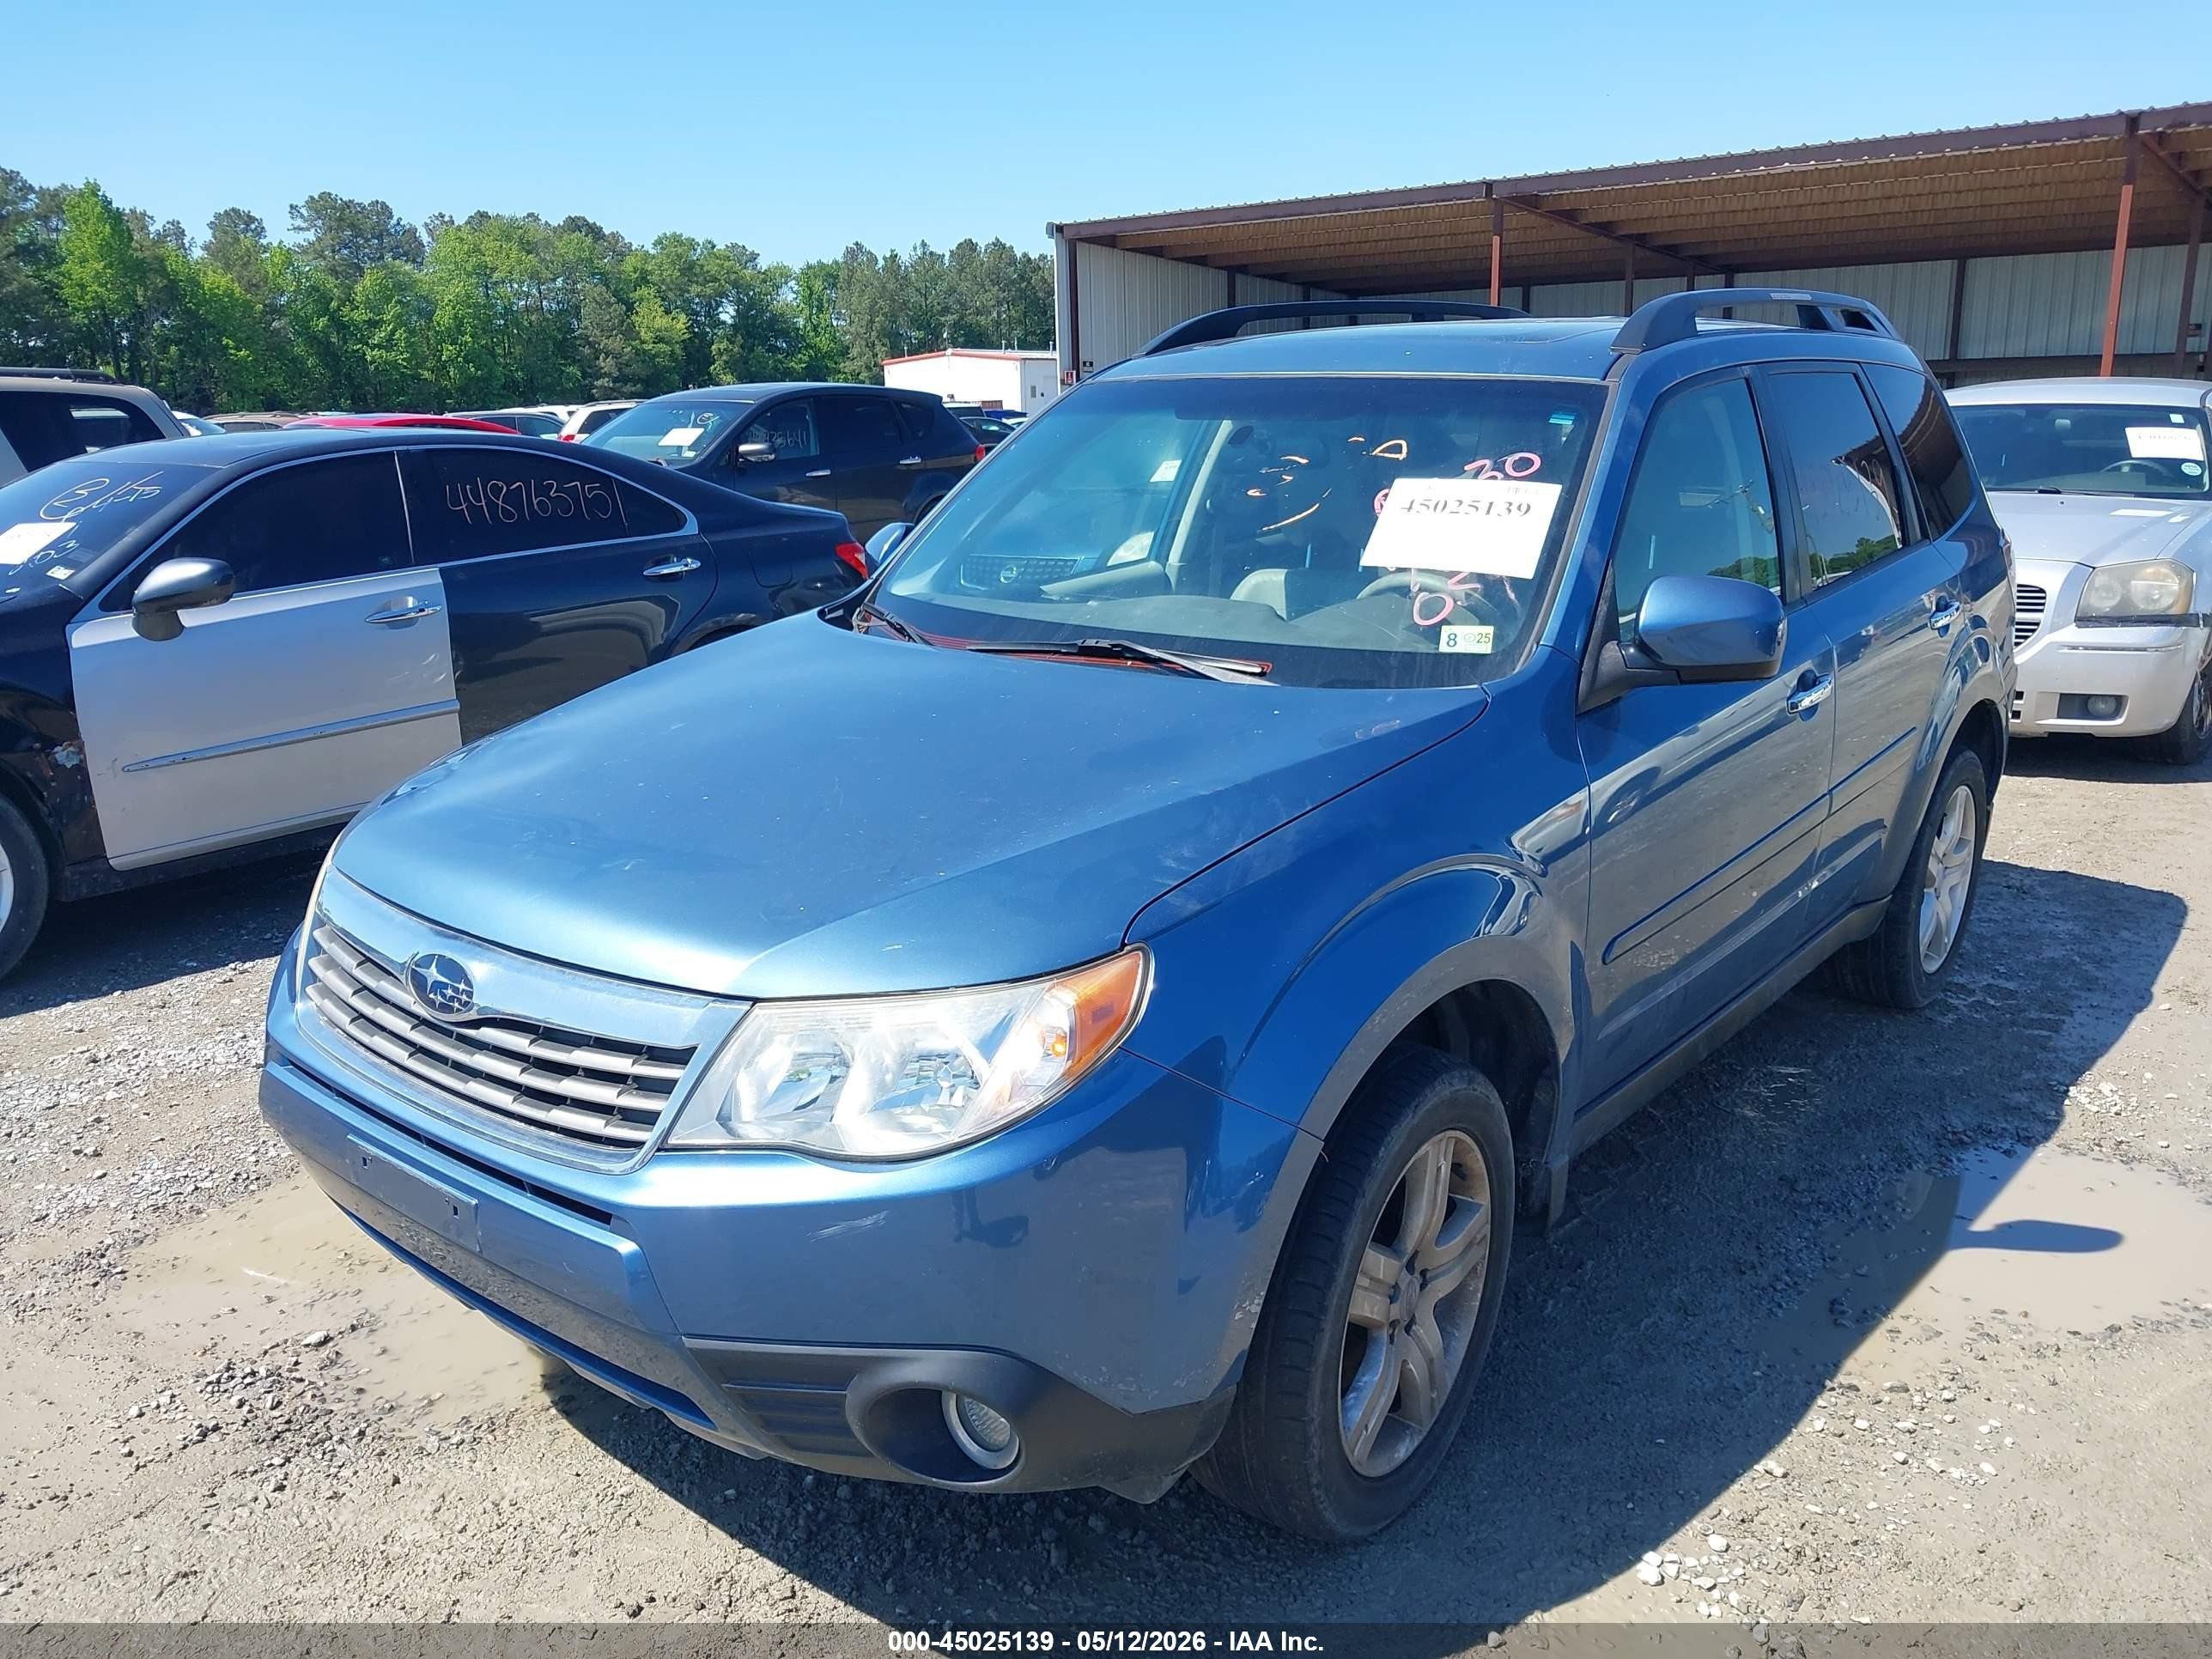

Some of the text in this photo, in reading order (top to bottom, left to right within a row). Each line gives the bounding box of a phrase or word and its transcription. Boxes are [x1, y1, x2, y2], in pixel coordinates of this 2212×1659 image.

[446, 477, 628, 526] 448763751
[1401, 498, 1531, 517] 45025139
[1446, 632, 1492, 647] 8 25
